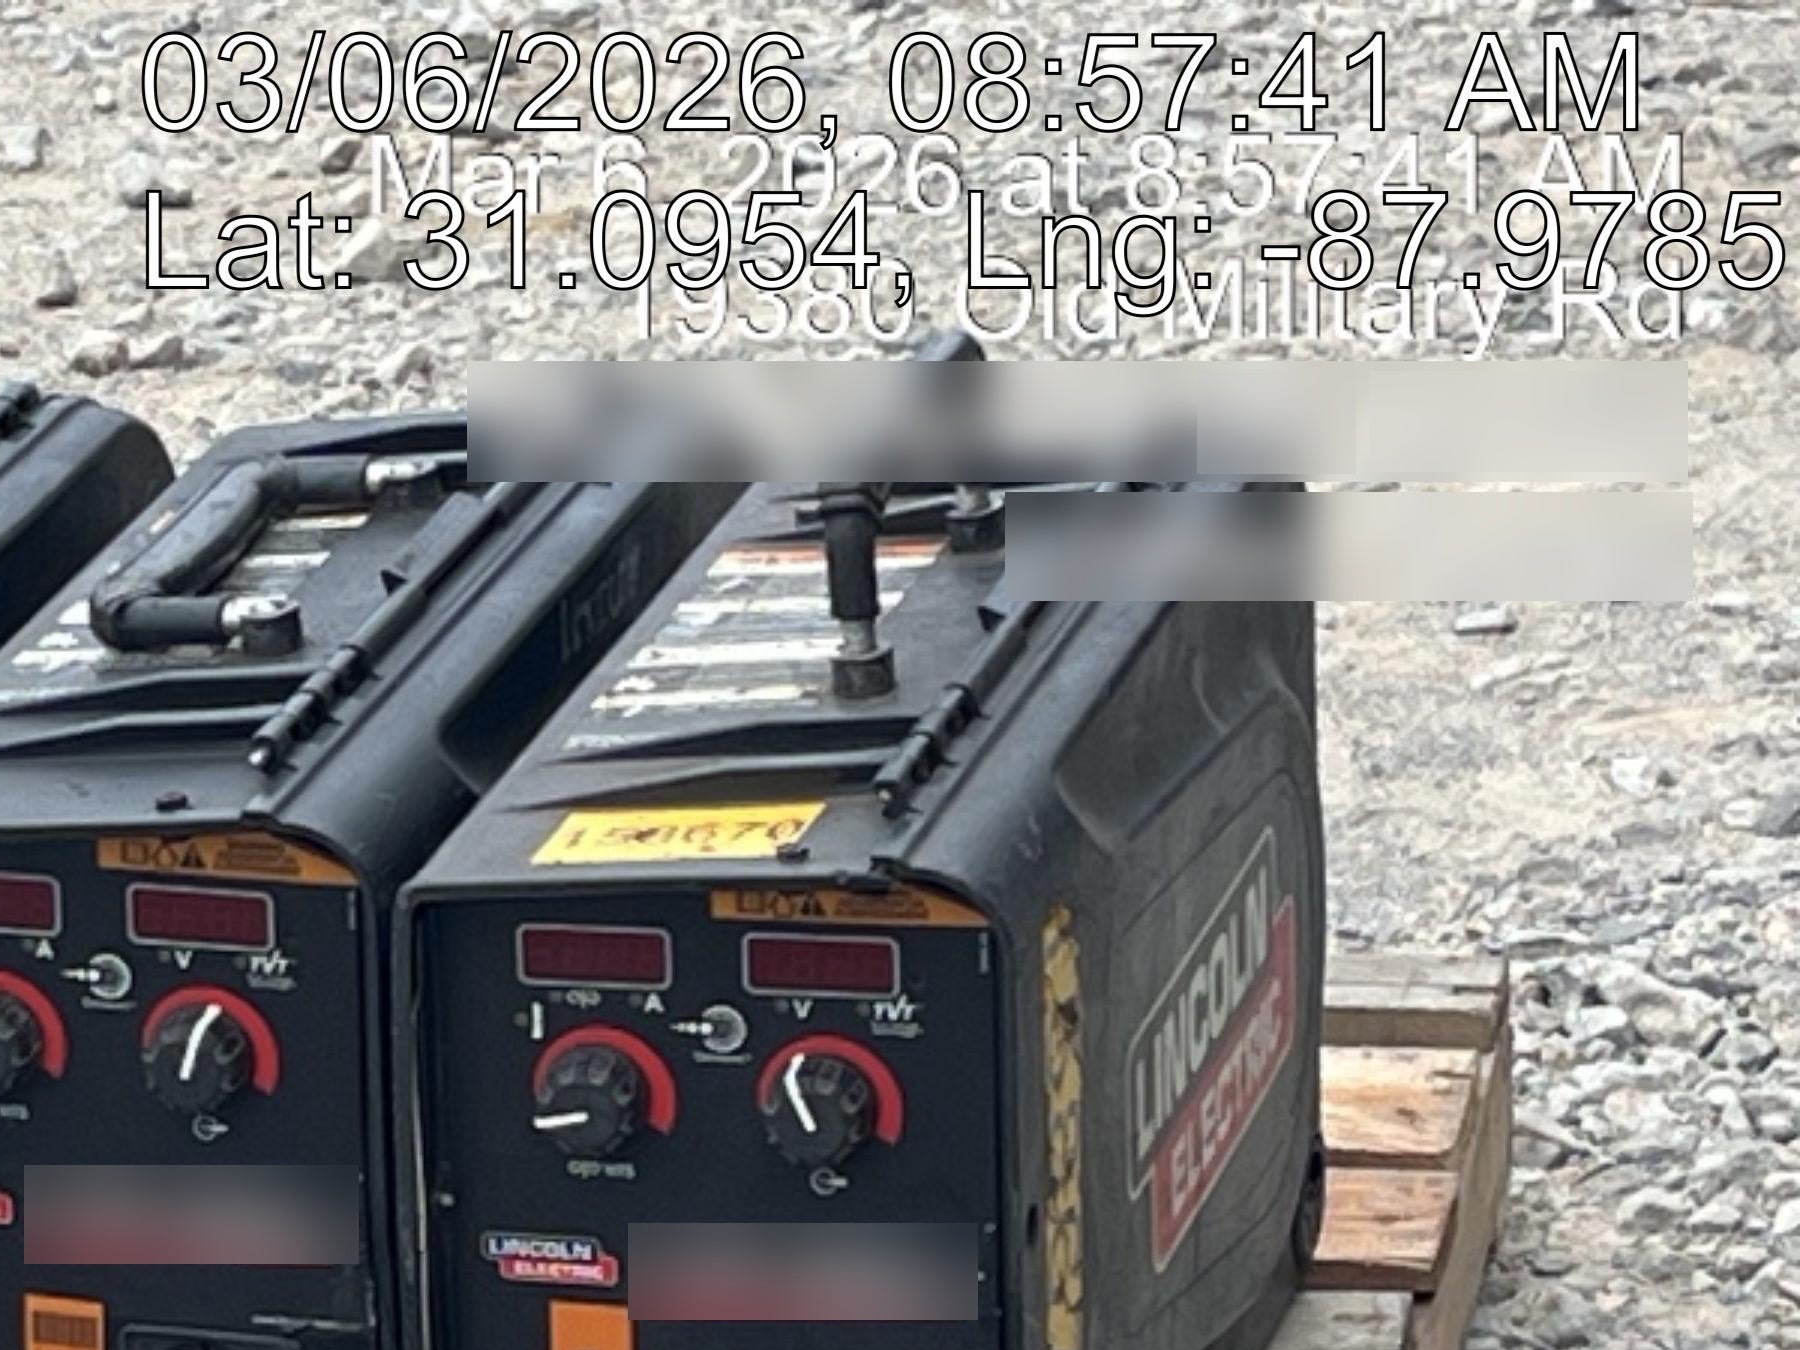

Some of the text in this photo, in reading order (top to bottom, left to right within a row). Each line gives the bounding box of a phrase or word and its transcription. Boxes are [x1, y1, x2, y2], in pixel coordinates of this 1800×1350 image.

[1135, 864, 1268, 1160] LINCOLN
[1171, 977, 1282, 1217] ELECTRIC
[487, 1237, 593, 1262] LINCOLN
